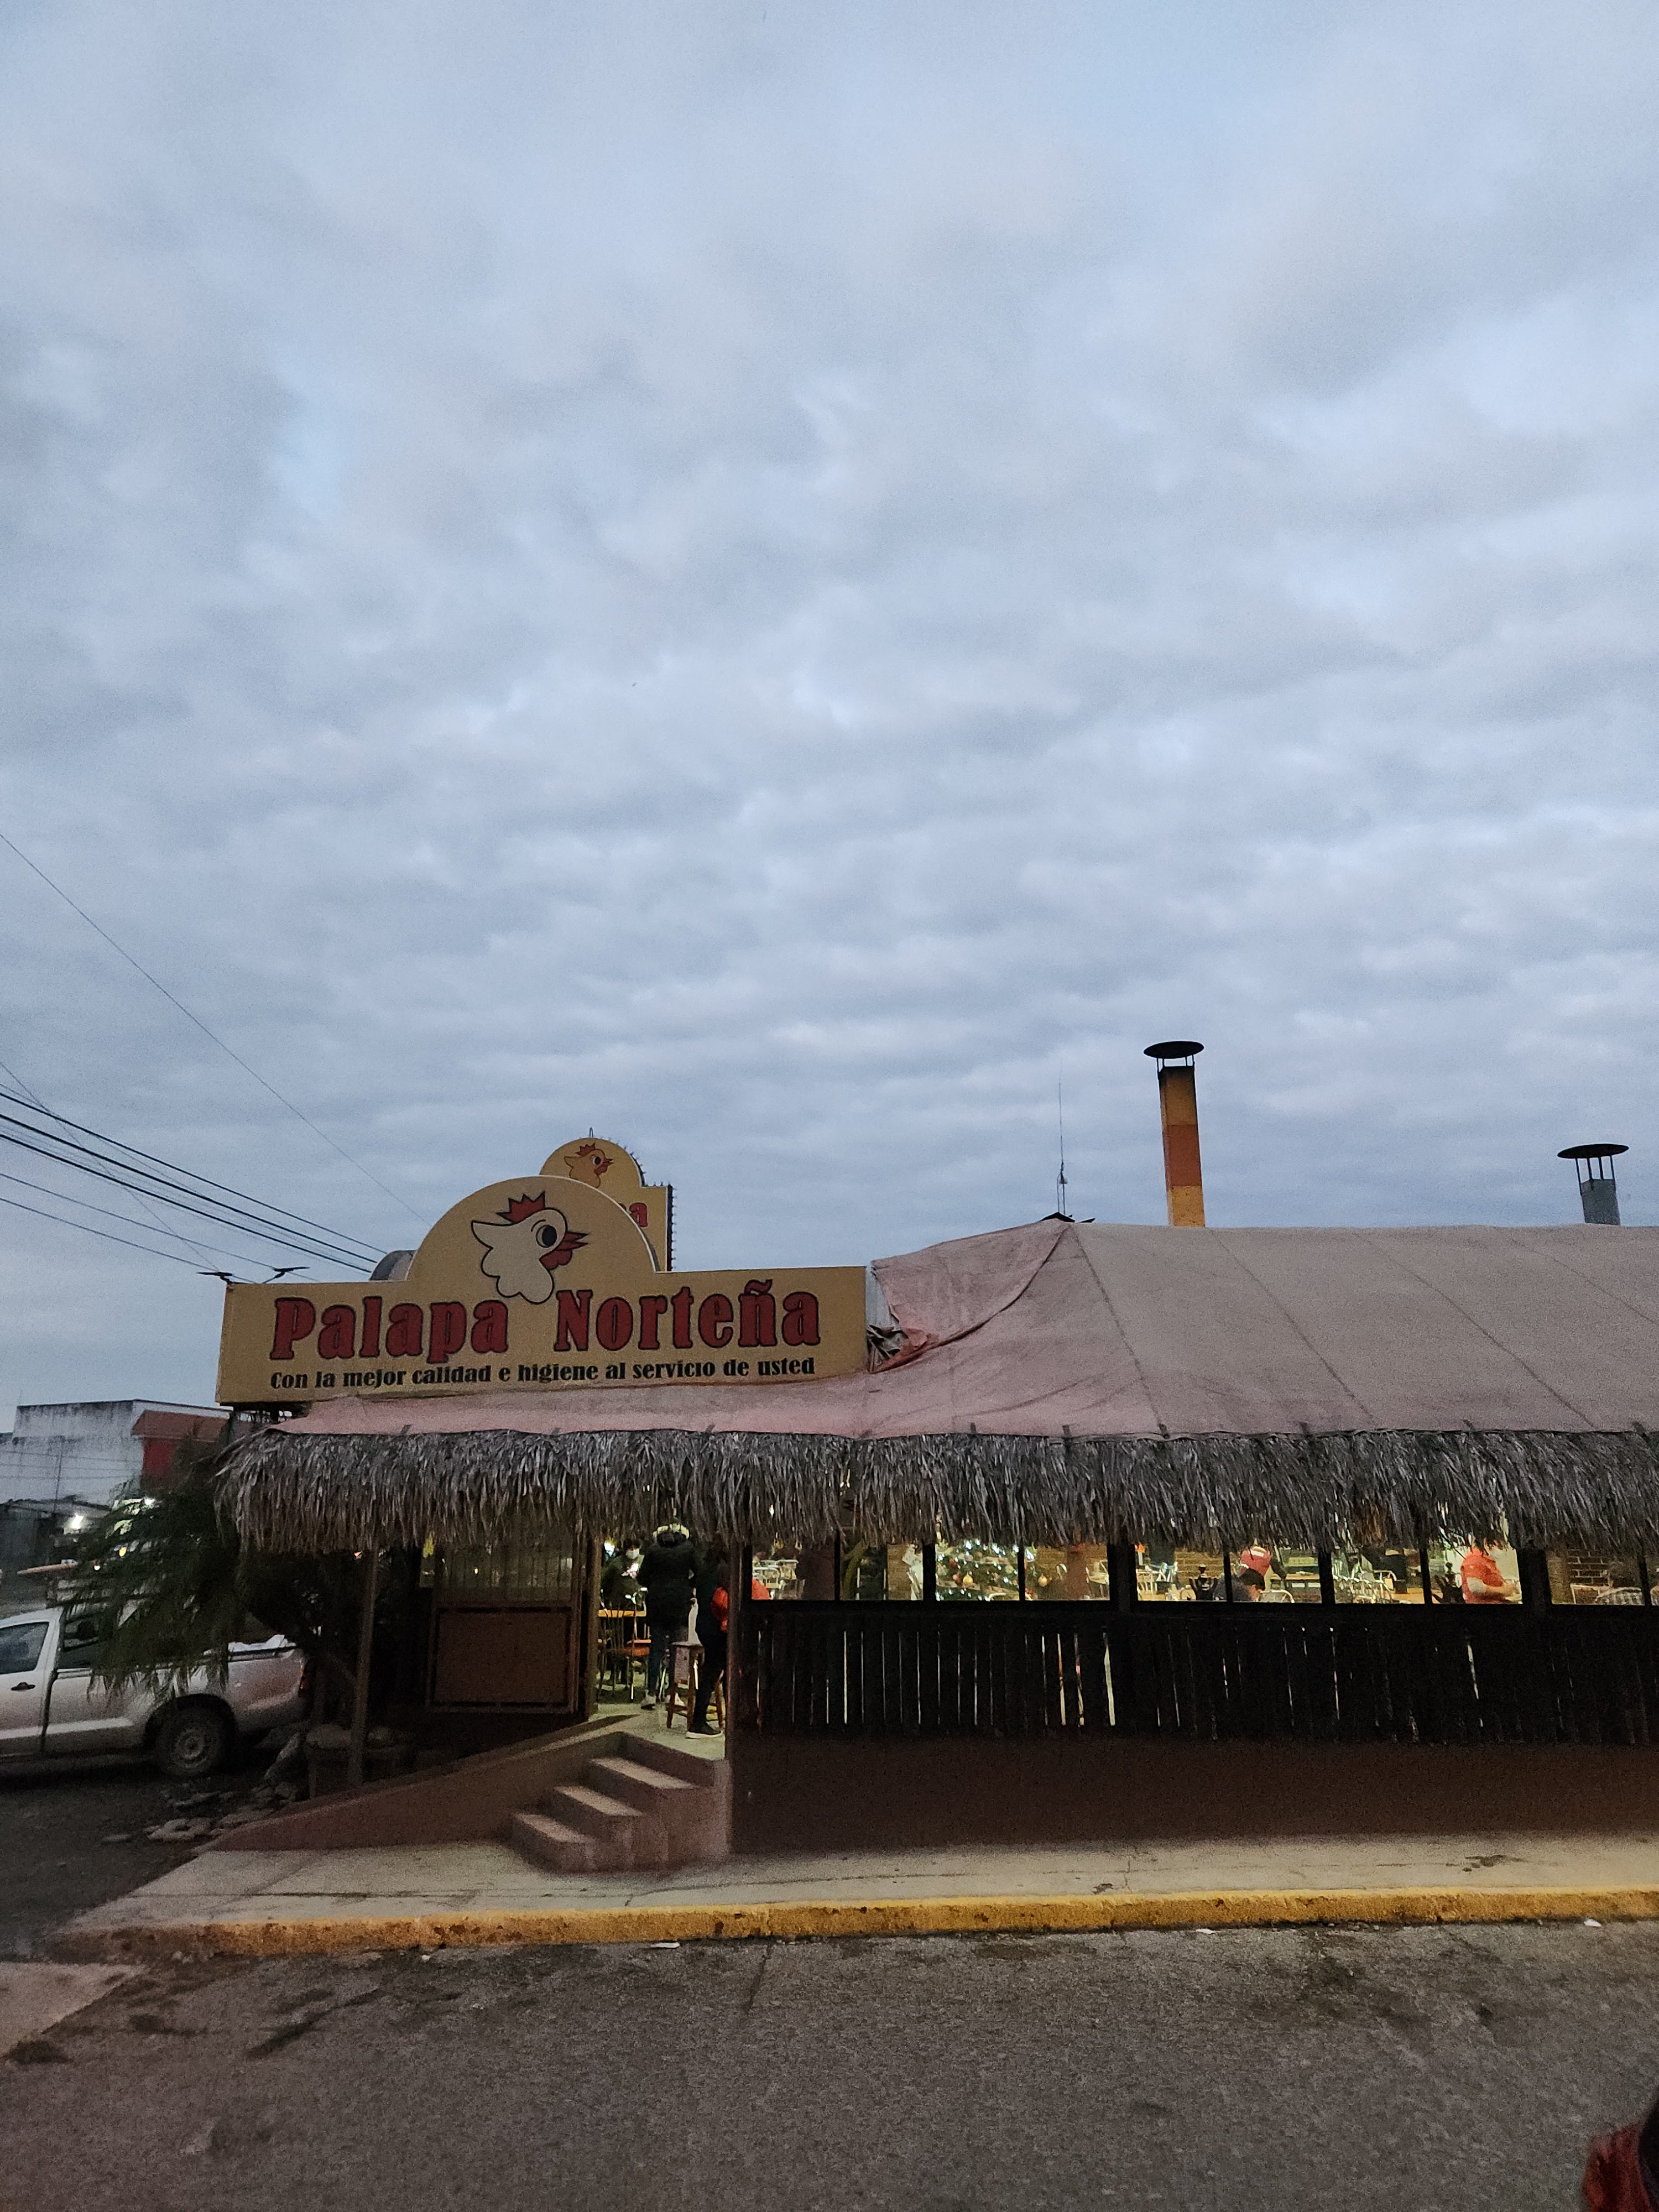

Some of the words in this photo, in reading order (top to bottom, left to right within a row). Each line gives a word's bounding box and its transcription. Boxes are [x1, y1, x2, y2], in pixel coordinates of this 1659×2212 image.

[269, 1296, 509, 1364] Palapa
[554, 1279, 821, 1351] Norteña
[270, 1372, 307, 1389] Con
[314, 1371, 336, 1387] la
[343, 1369, 405, 1387] mejor
[411, 1365, 492, 1384] calidad
[498, 1368, 511, 1381] e
[517, 1362, 598, 1383] higiene
[606, 1361, 625, 1379] al
[633, 1359, 716, 1379] servicio
[723, 1359, 749, 1376] de
[758, 1357, 815, 1375] usted
